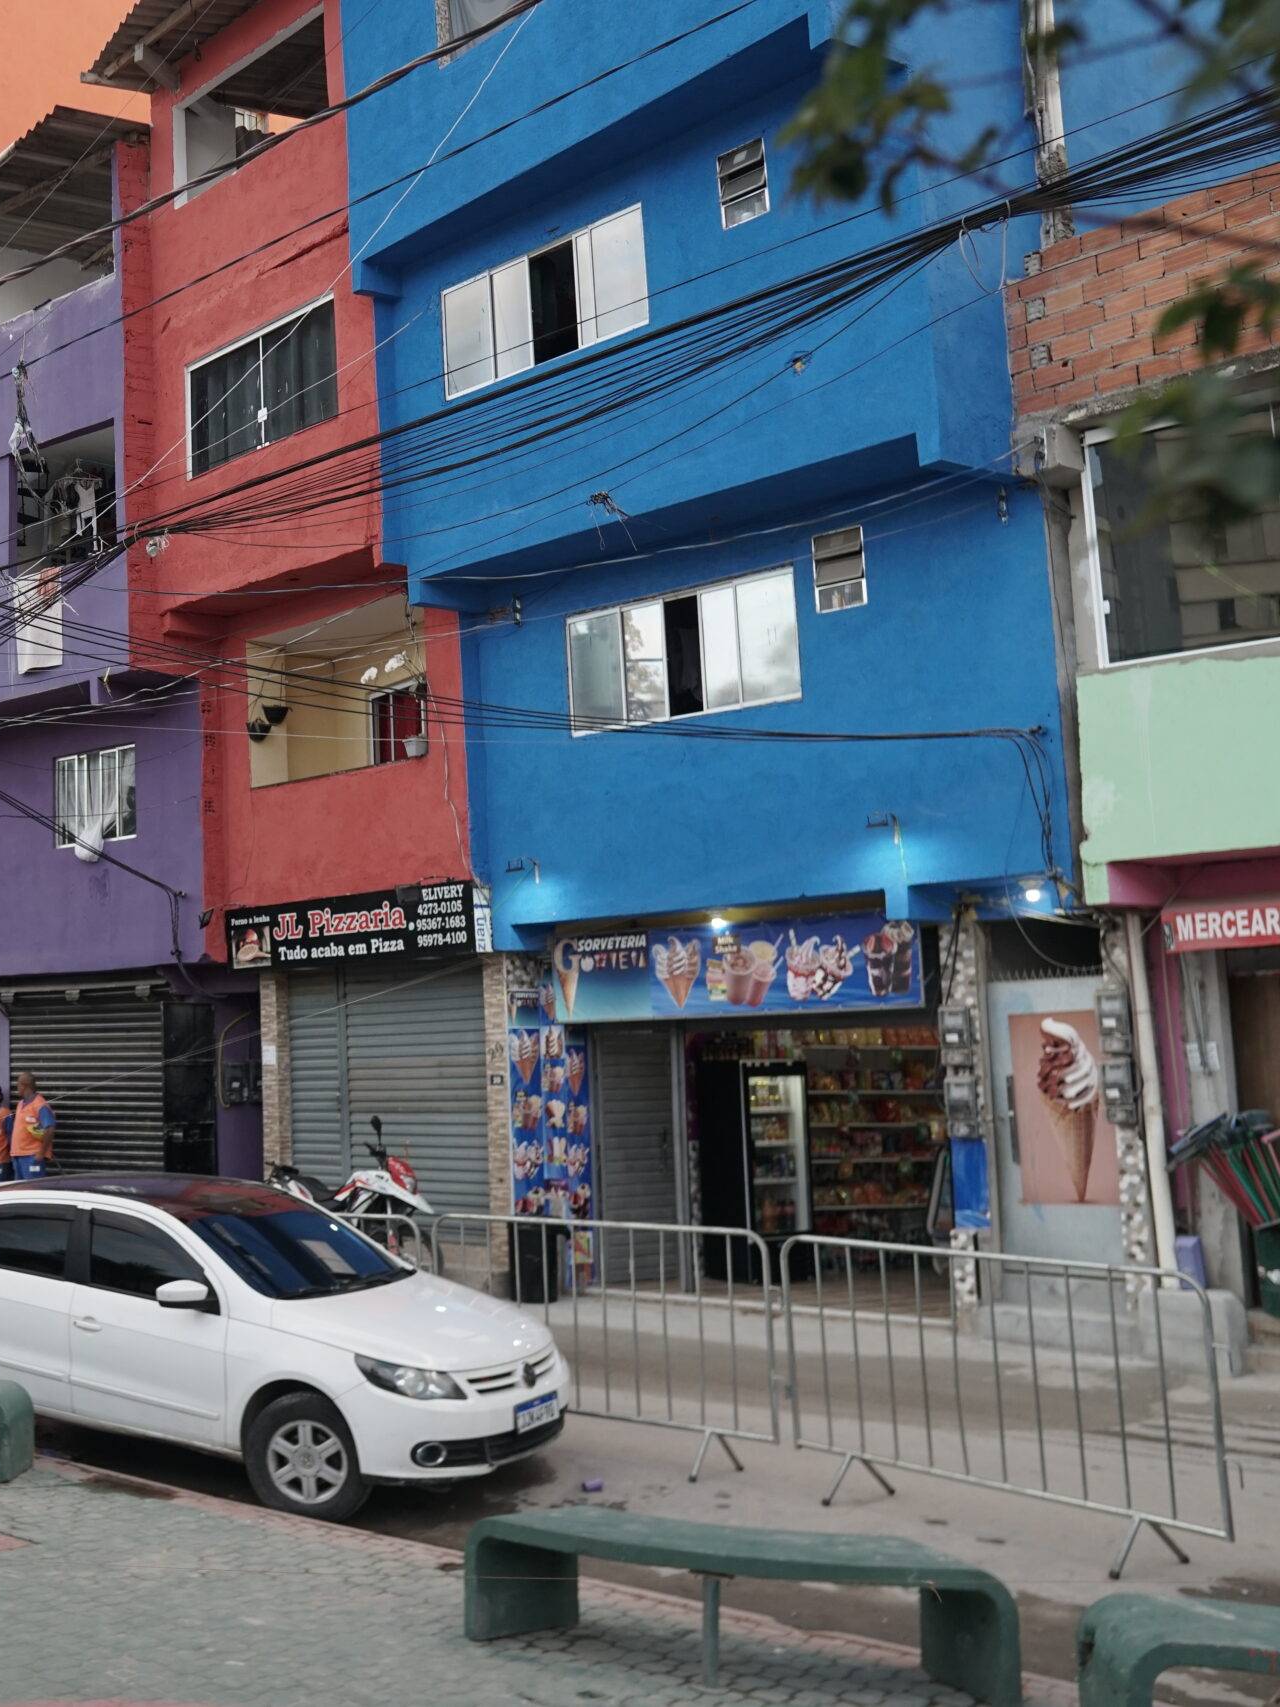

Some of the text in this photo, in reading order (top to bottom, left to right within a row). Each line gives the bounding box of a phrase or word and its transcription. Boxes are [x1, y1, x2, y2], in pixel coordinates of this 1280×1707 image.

[421, 884, 464, 901] ELIVERY
[417, 900, 463, 915] 4273-0105
[273, 900, 407, 941] JL Pizzaria
[416, 915, 466, 931] 95367-1683
[1175, 907, 1280, 941] MERCEAR
[416, 931, 467, 947] 95978-4100
[577, 934, 647, 953] SORVETERIA
[278, 937, 404, 961] Tudo acaba em Pizza
